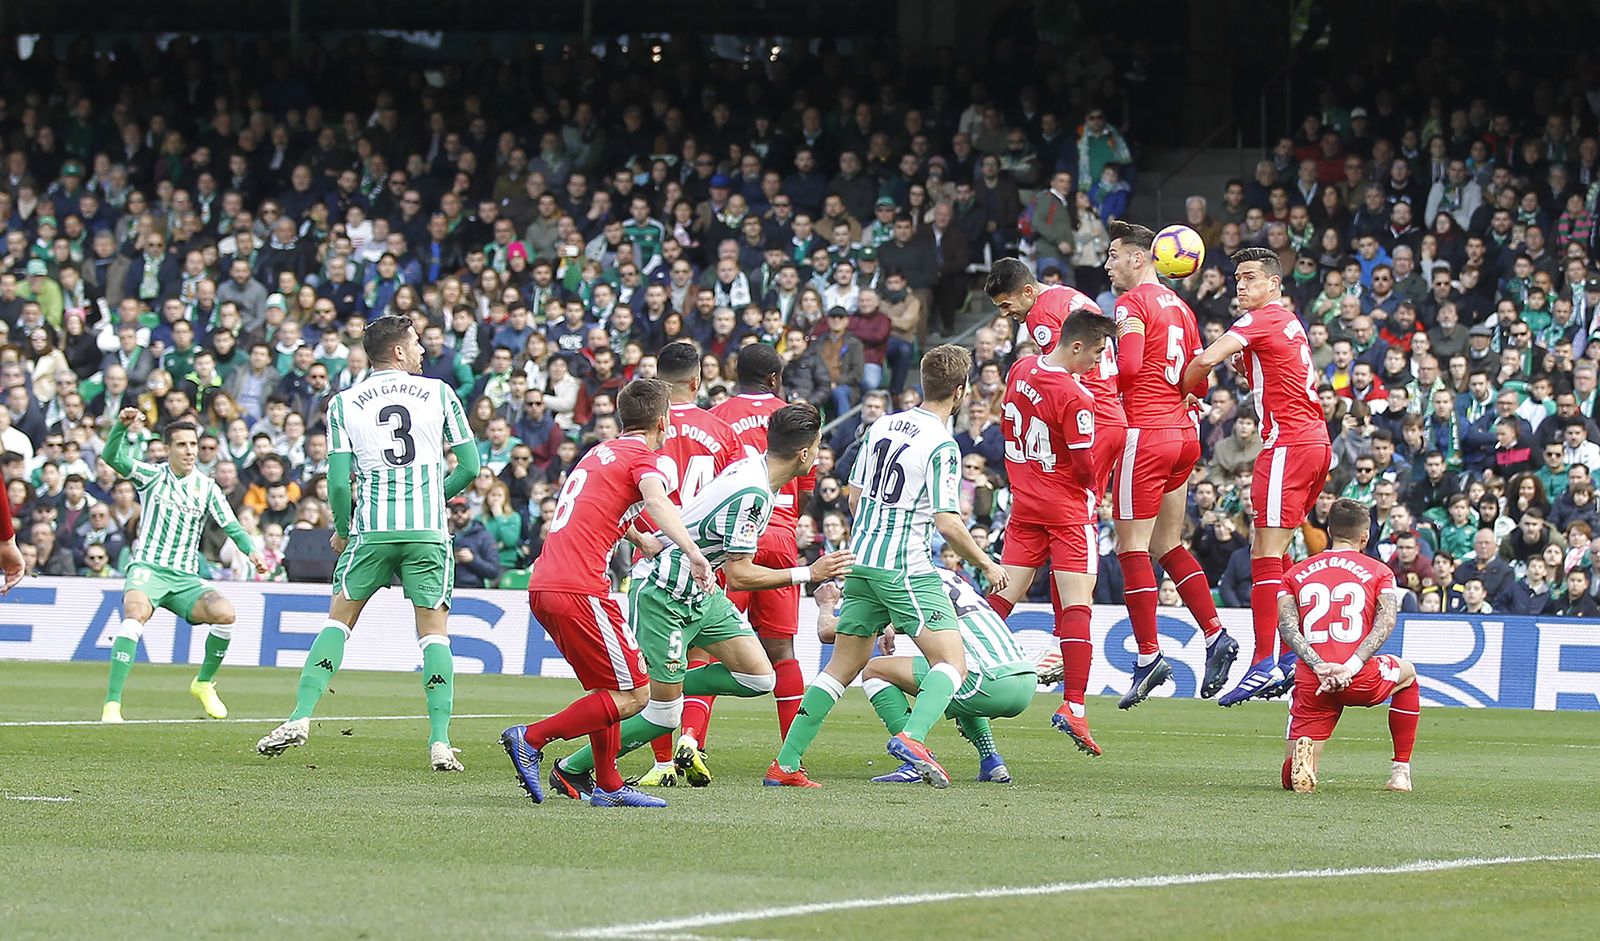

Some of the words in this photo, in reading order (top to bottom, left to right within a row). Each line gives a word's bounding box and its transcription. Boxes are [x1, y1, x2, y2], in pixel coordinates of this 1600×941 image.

[1164, 325, 1185, 386] 5
[352, 388, 379, 411] JAVI
[381, 384, 430, 402] GARCIA
[376, 404, 416, 468] 3
[681, 423, 723, 453] PORRO
[732, 414, 770, 435] DOUM
[888, 419, 921, 439] LOREN
[1000, 401, 1057, 473] 34
[869, 437, 911, 505] 16
[549, 468, 588, 533] 8
[1294, 558, 1329, 584] ALEIX
[1328, 556, 1373, 584] GARCIA
[1299, 581, 1367, 645] 23
[667, 630, 683, 659] 5
